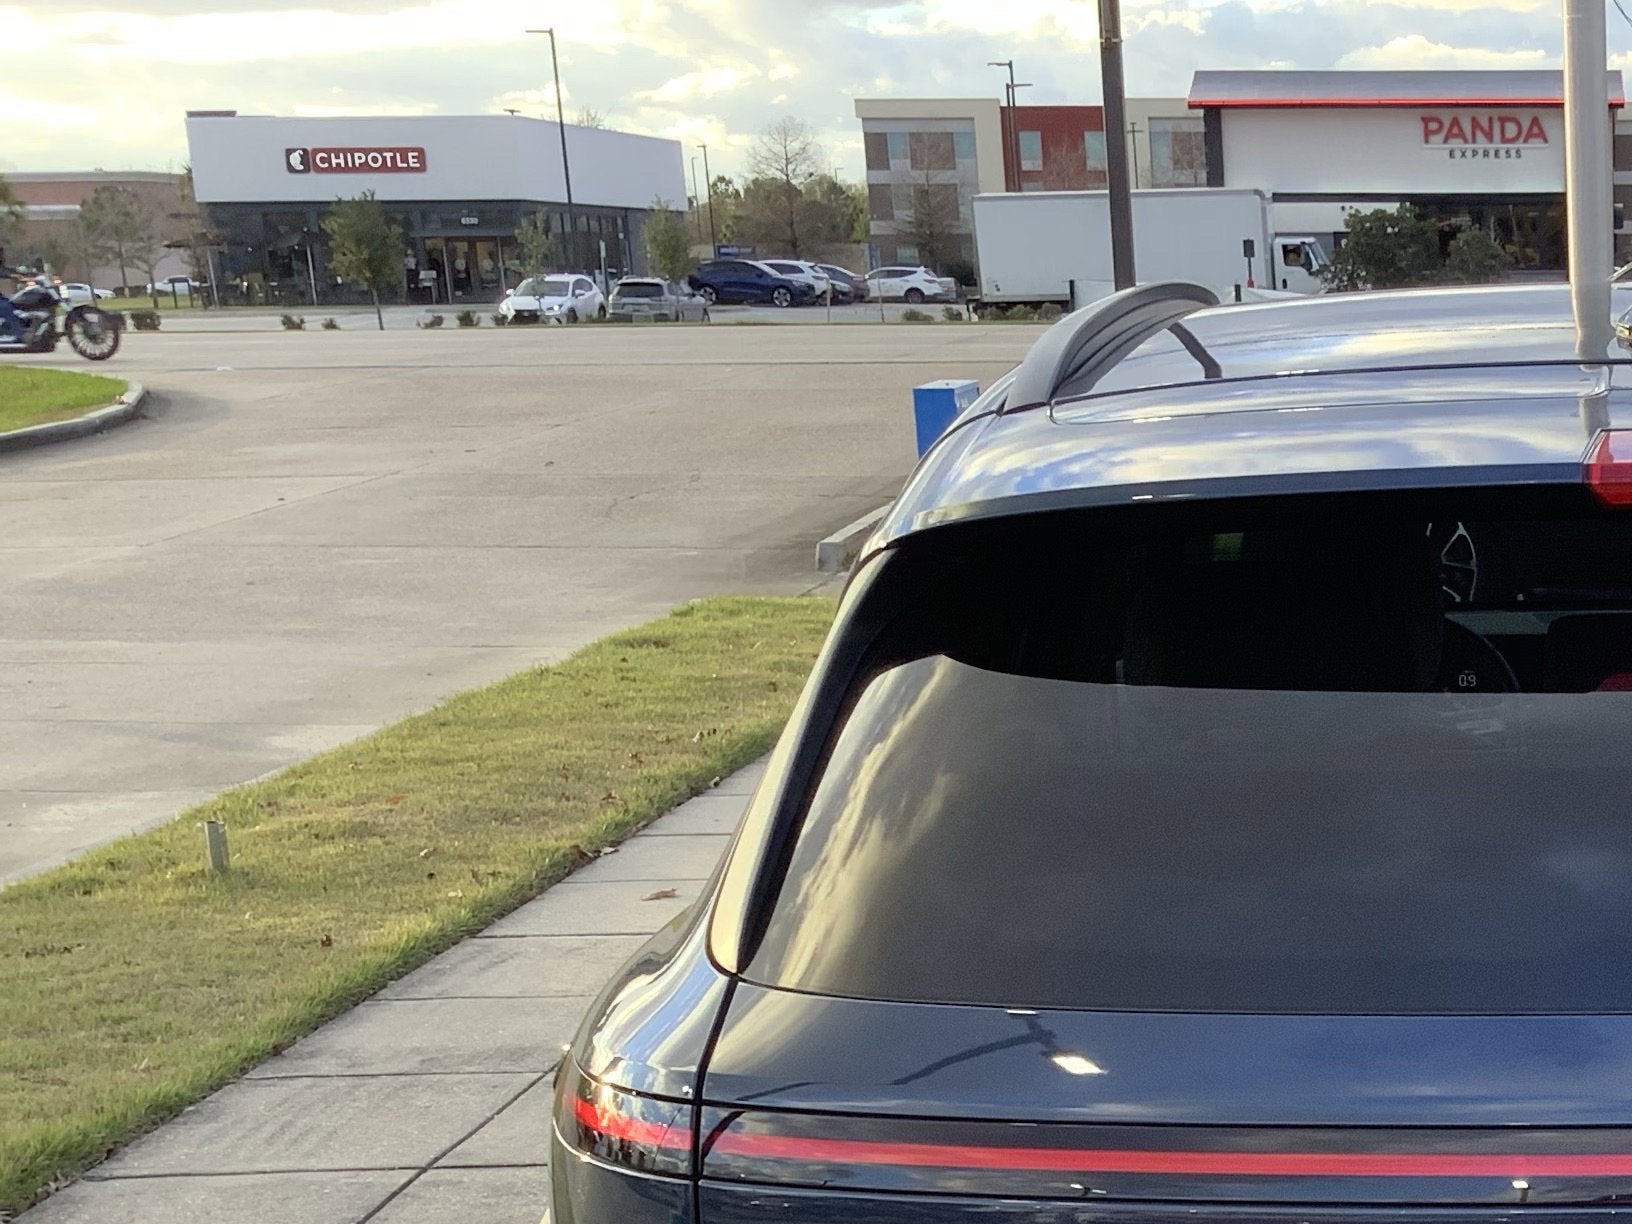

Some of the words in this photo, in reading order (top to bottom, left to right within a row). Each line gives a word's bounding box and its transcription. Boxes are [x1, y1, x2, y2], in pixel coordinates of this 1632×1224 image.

[1420, 115, 1549, 144] PANDA
[315, 151, 420, 168] CHIPOTLE
[1449, 148, 1522, 159] EXPRESS
